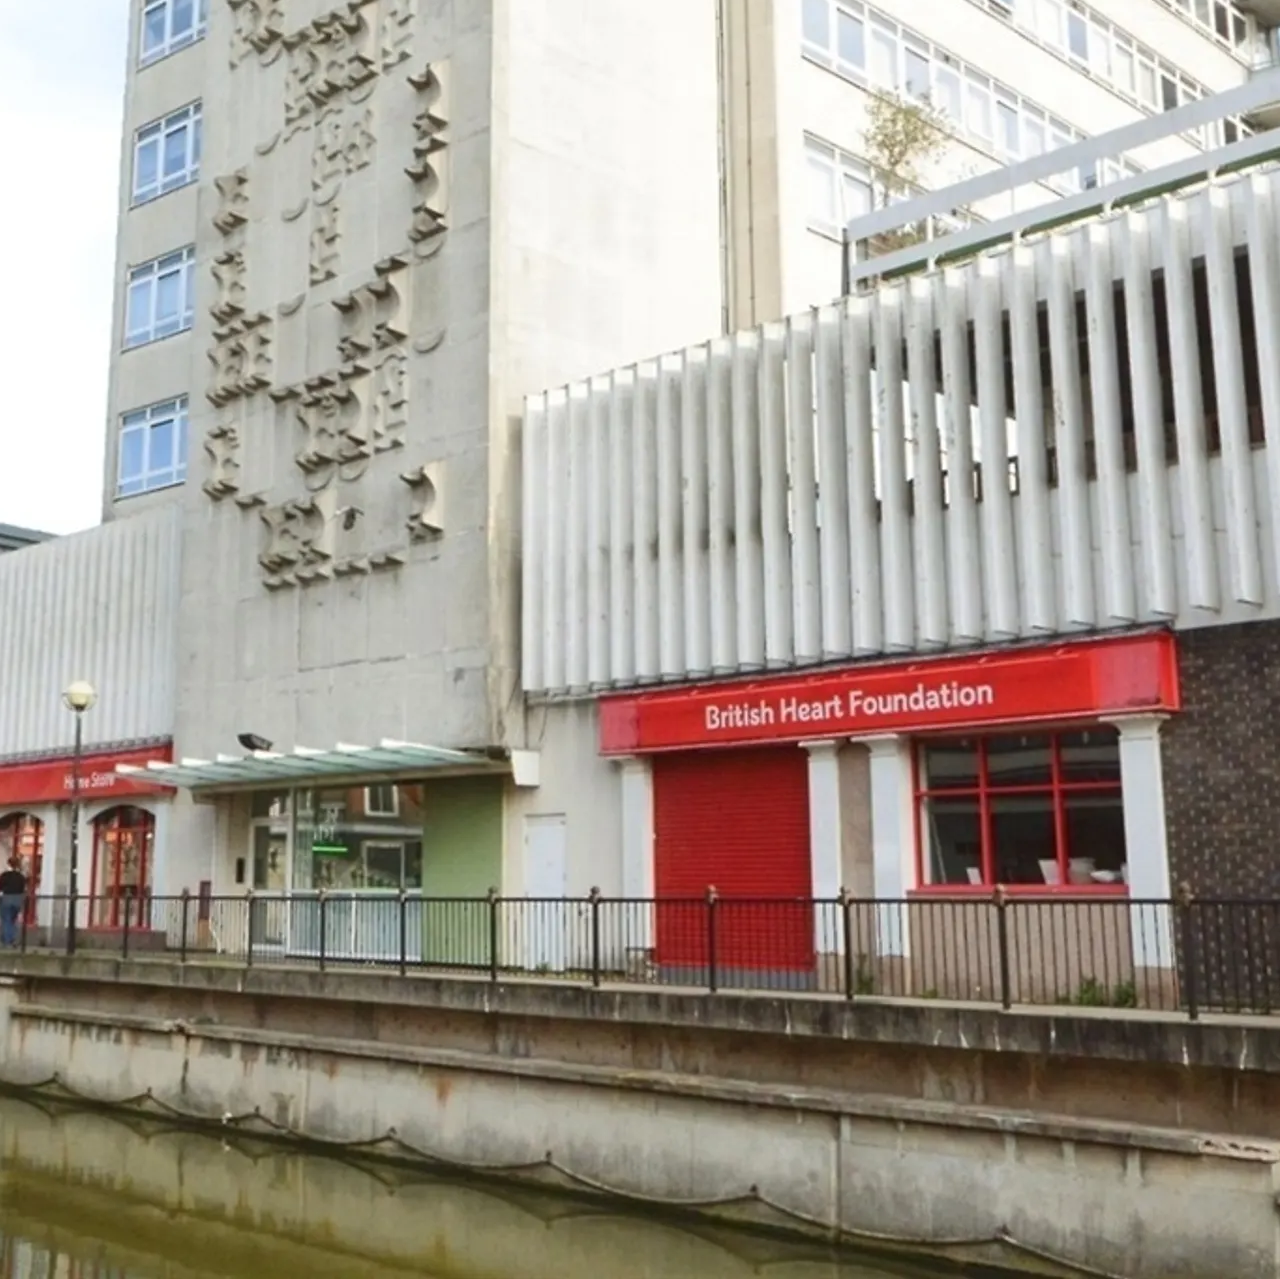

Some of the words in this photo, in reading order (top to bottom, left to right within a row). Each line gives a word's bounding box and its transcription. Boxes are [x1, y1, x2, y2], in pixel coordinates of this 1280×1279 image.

[705, 700, 774, 729] British
[780, 694, 843, 721] Heart
[849, 681, 993, 716] Foundation
